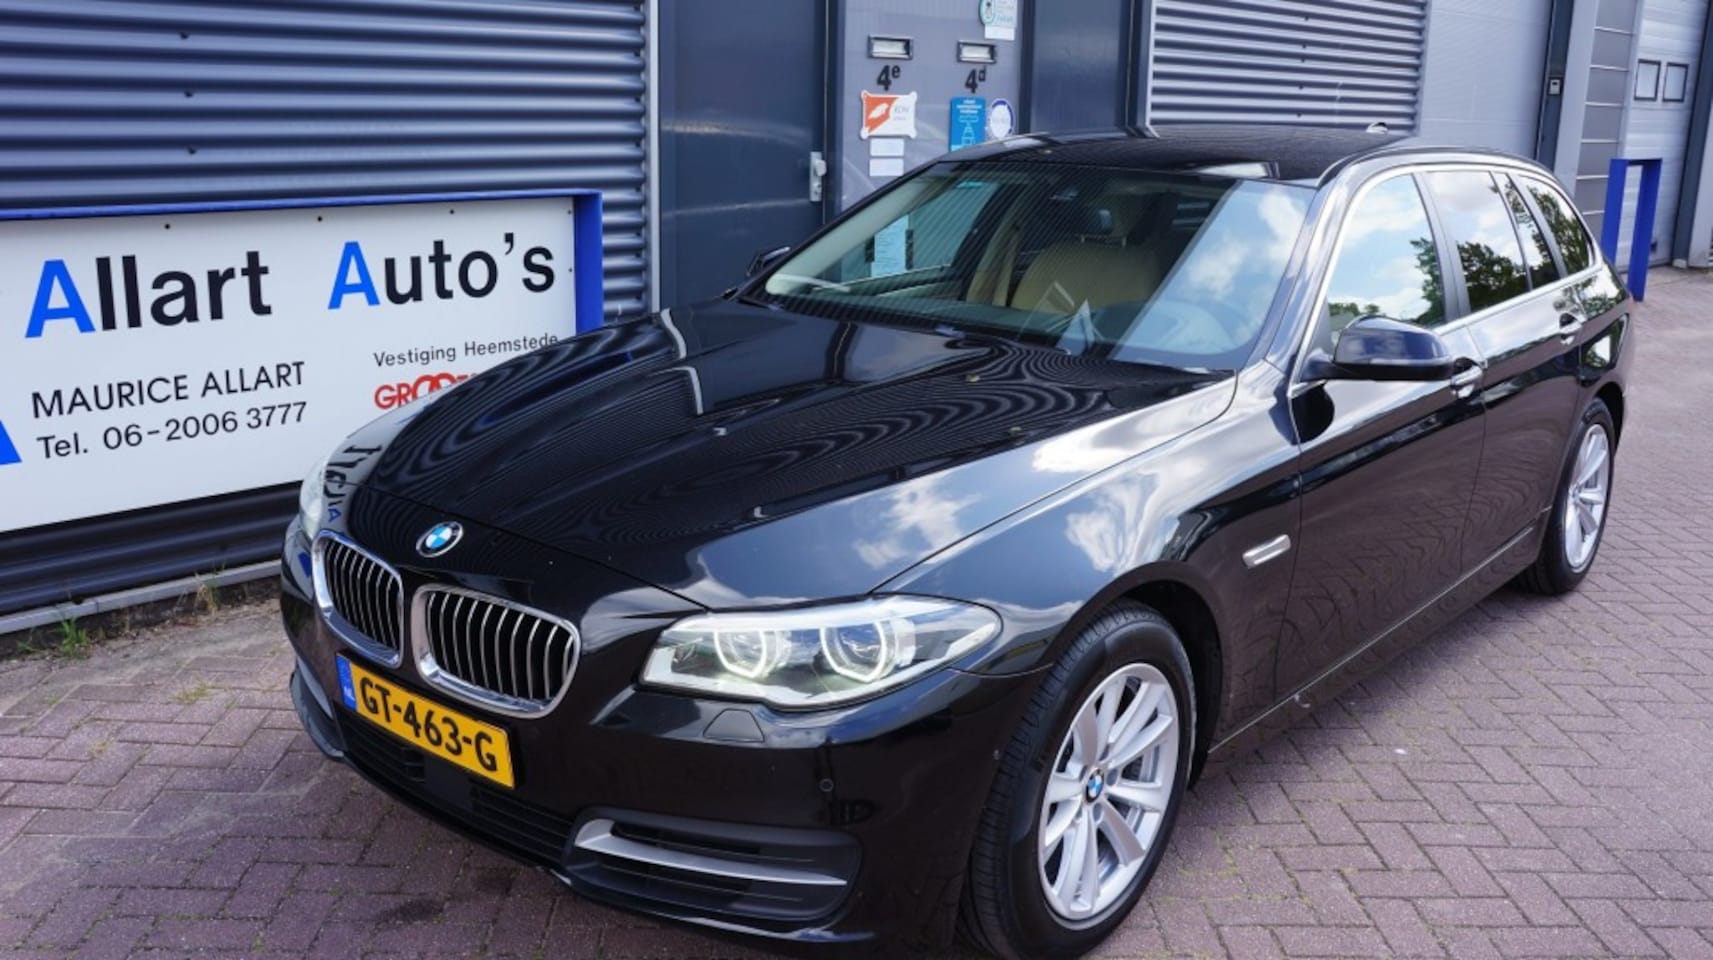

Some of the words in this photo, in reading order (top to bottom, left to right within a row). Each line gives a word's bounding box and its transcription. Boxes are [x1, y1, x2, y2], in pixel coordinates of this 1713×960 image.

[24, 251, 273, 339] Allart
[327, 232, 556, 310] Auto's
[373, 346, 456, 367] Vestiging
[464, 333, 559, 357] Heemstede
[31, 374, 189, 419] MAURICE
[200, 360, 305, 398] ALLART
[36, 432, 88, 459] Tel.
[246, 401, 307, 430] 3777
[359, 676, 498, 772] GT-463-G
